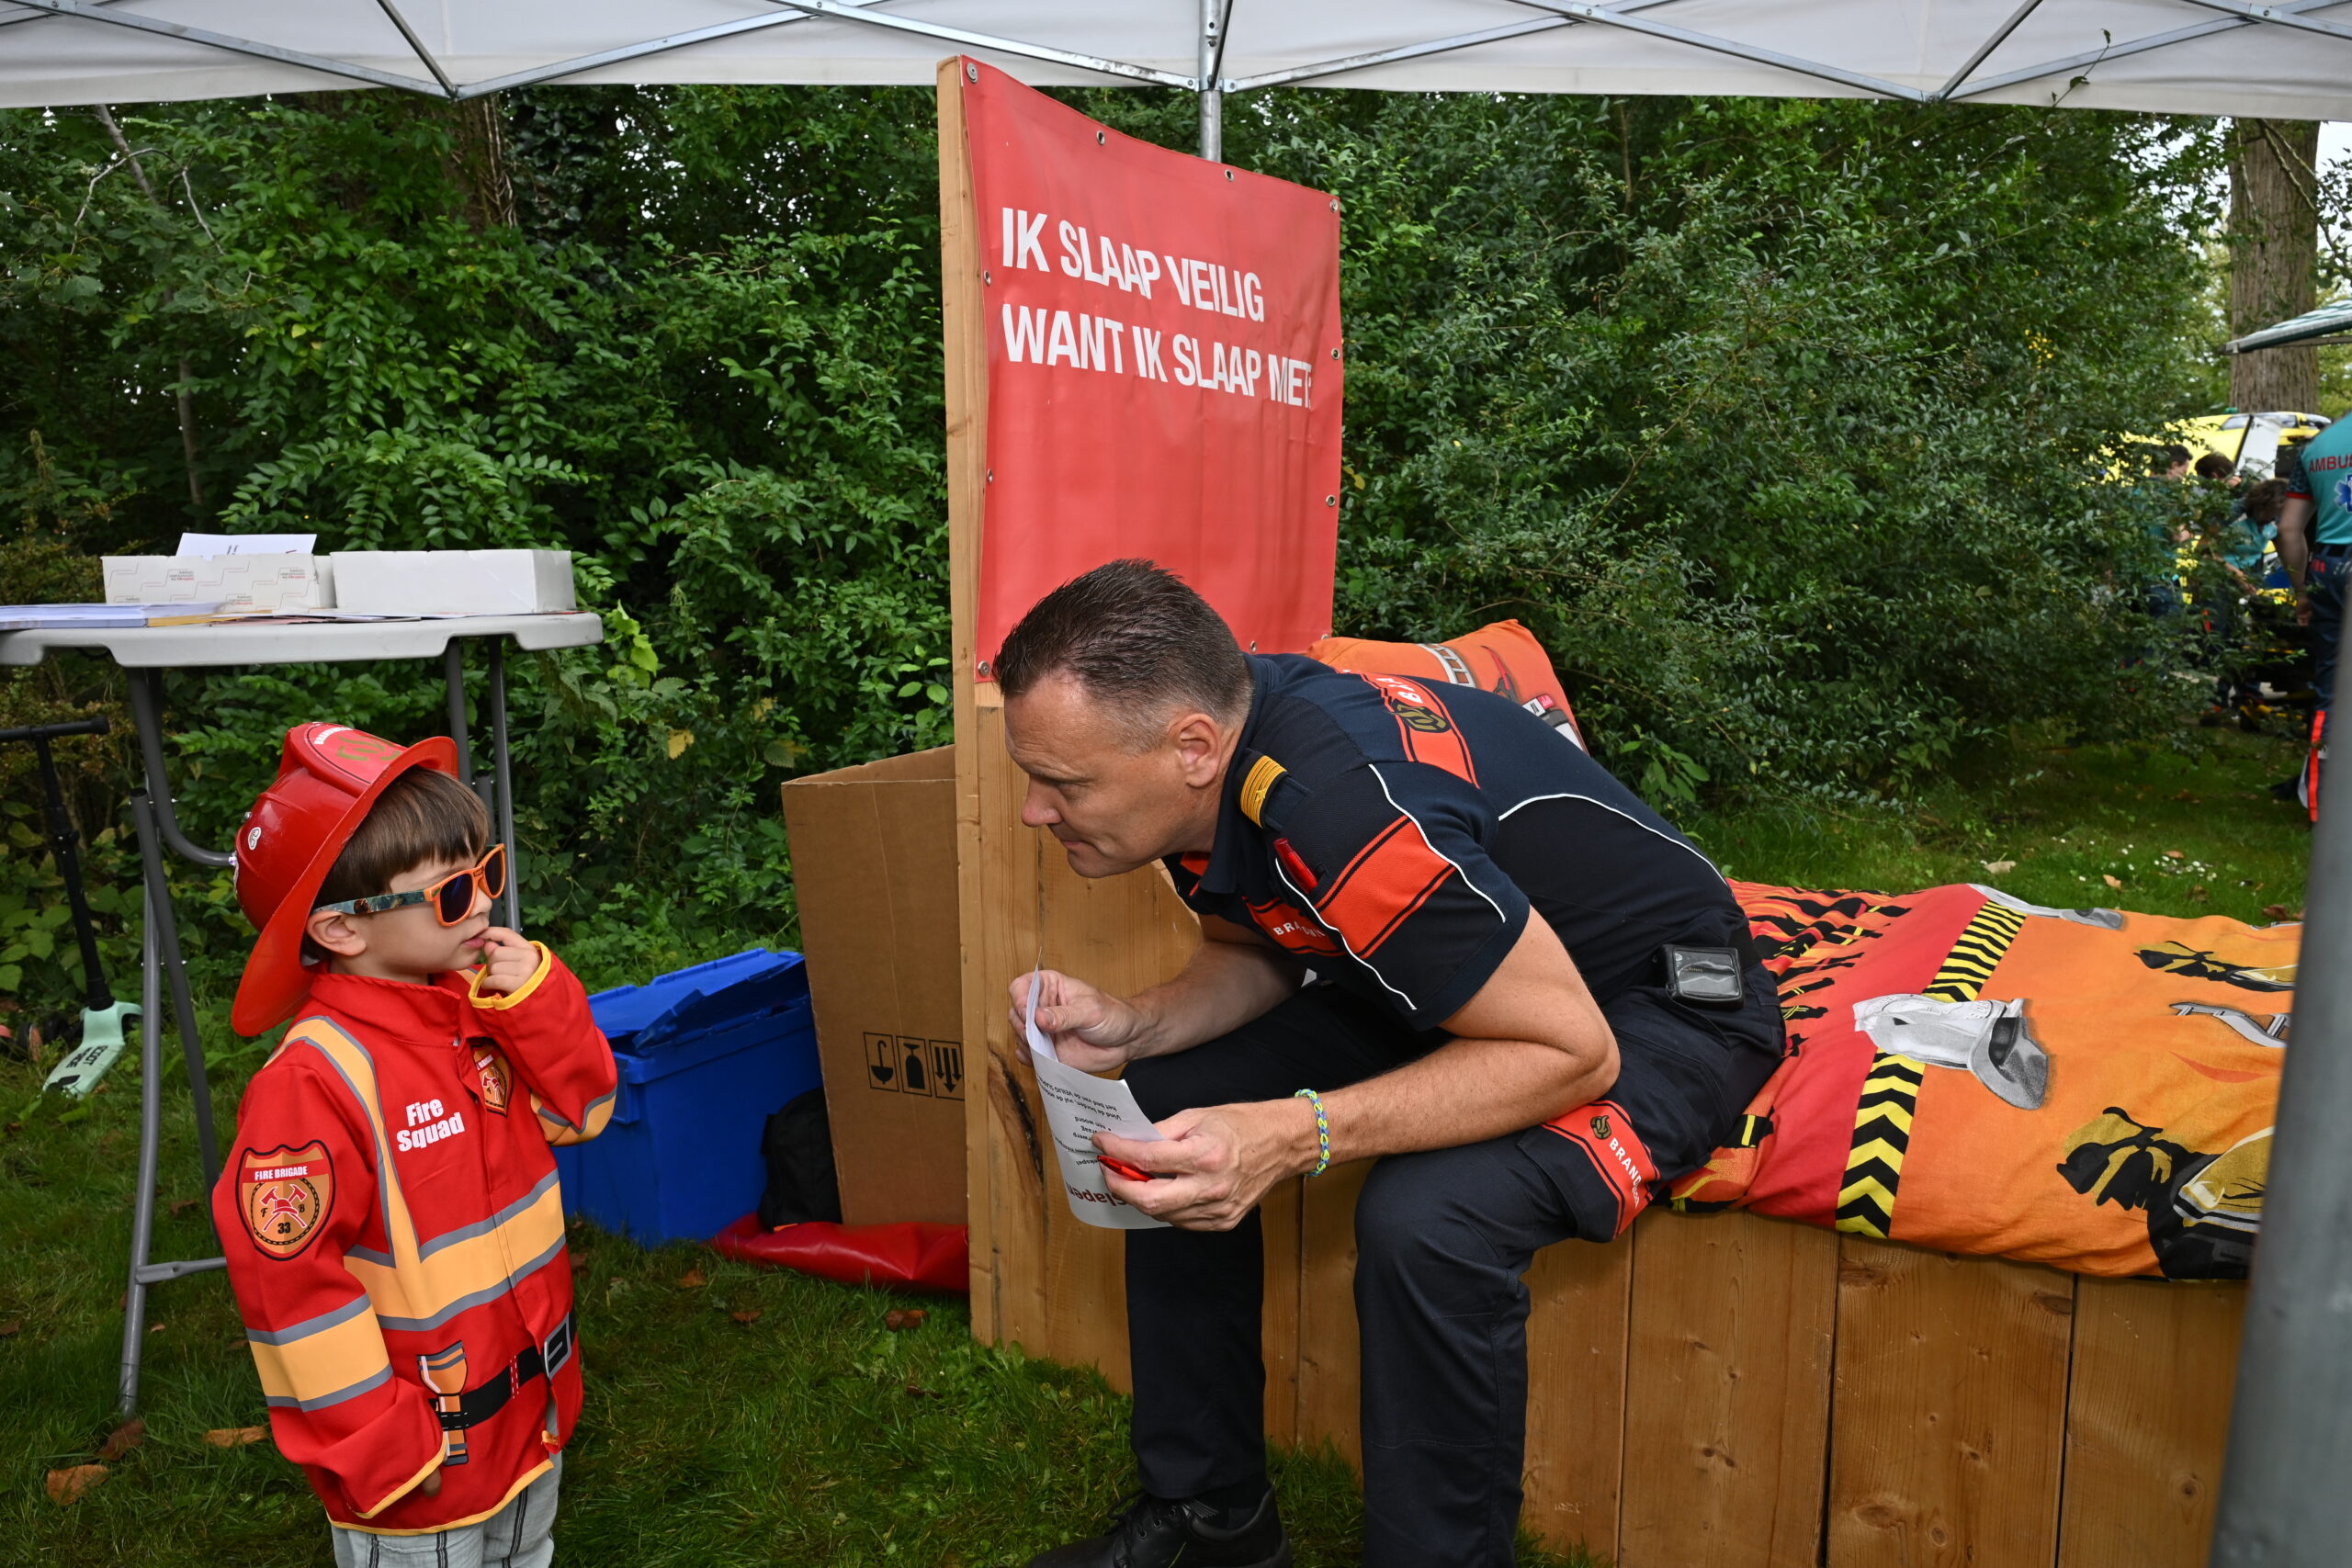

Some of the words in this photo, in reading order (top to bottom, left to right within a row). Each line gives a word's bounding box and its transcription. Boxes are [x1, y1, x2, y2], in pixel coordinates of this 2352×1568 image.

[1002, 207, 1050, 273] IK
[1058, 220, 1160, 300] SLAAP
[1164, 255, 1265, 322] VEILIG
[1002, 303, 1125, 374] WANT
[1132, 326, 1169, 383] IK
[1172, 333, 1261, 397] SLAAP
[2309, 455, 2352, 472] AMBU
[406, 1099, 444, 1127] Fire
[1074, 1116, 1095, 1125] woord
[396, 1111, 466, 1152] Squad
[254, 1169, 274, 1181] FIRE
[274, 1166, 308, 1179] BRIGADE
[277, 1222, 291, 1235] 33
